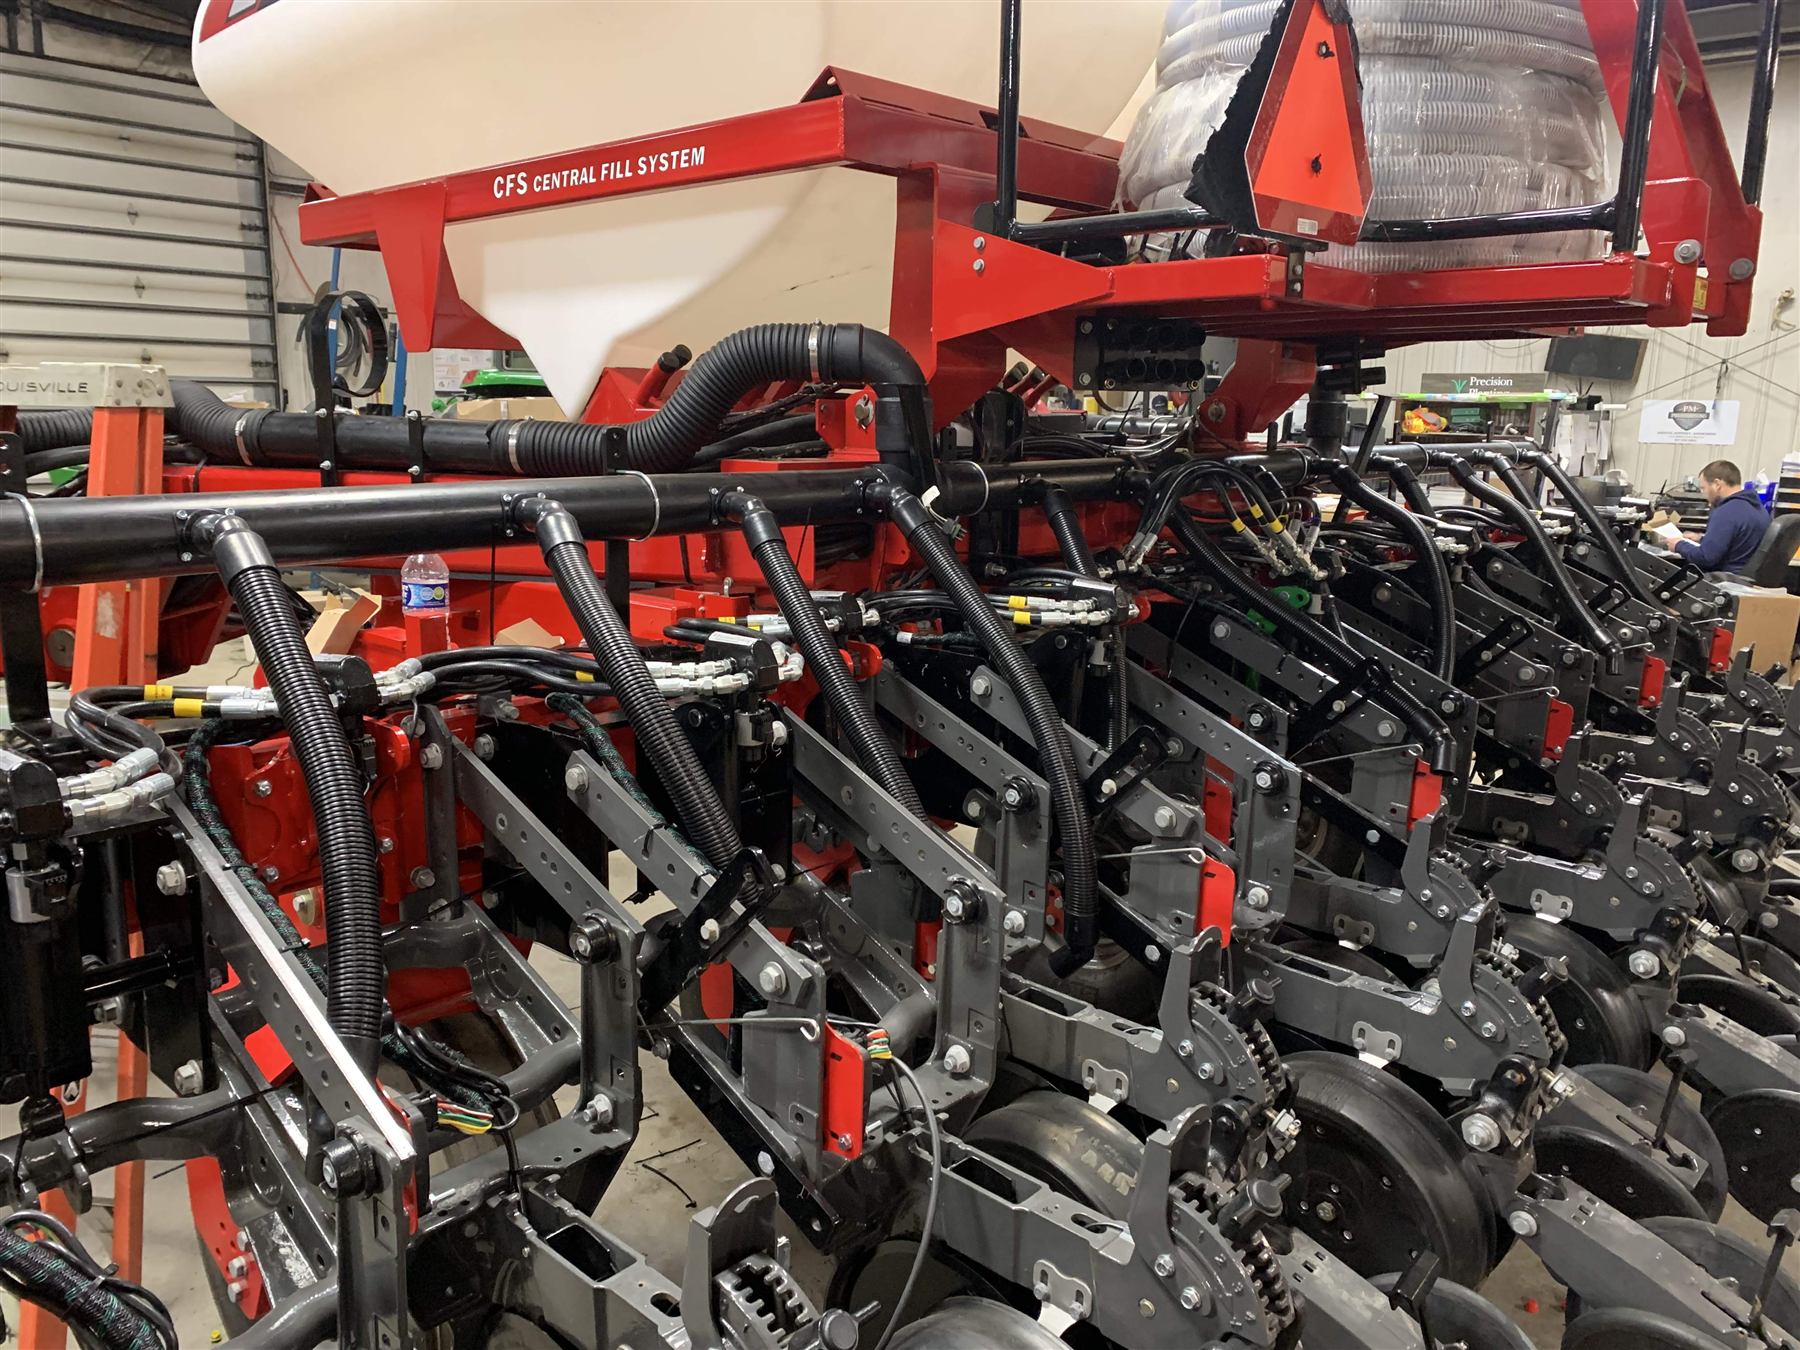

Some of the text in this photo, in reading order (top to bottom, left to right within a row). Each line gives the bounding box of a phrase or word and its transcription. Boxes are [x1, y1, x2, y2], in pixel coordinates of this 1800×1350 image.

[493, 146, 705, 199] CFS CENTRAL FILL SYSTEM
[1469, 376, 1513, 386] Precision
